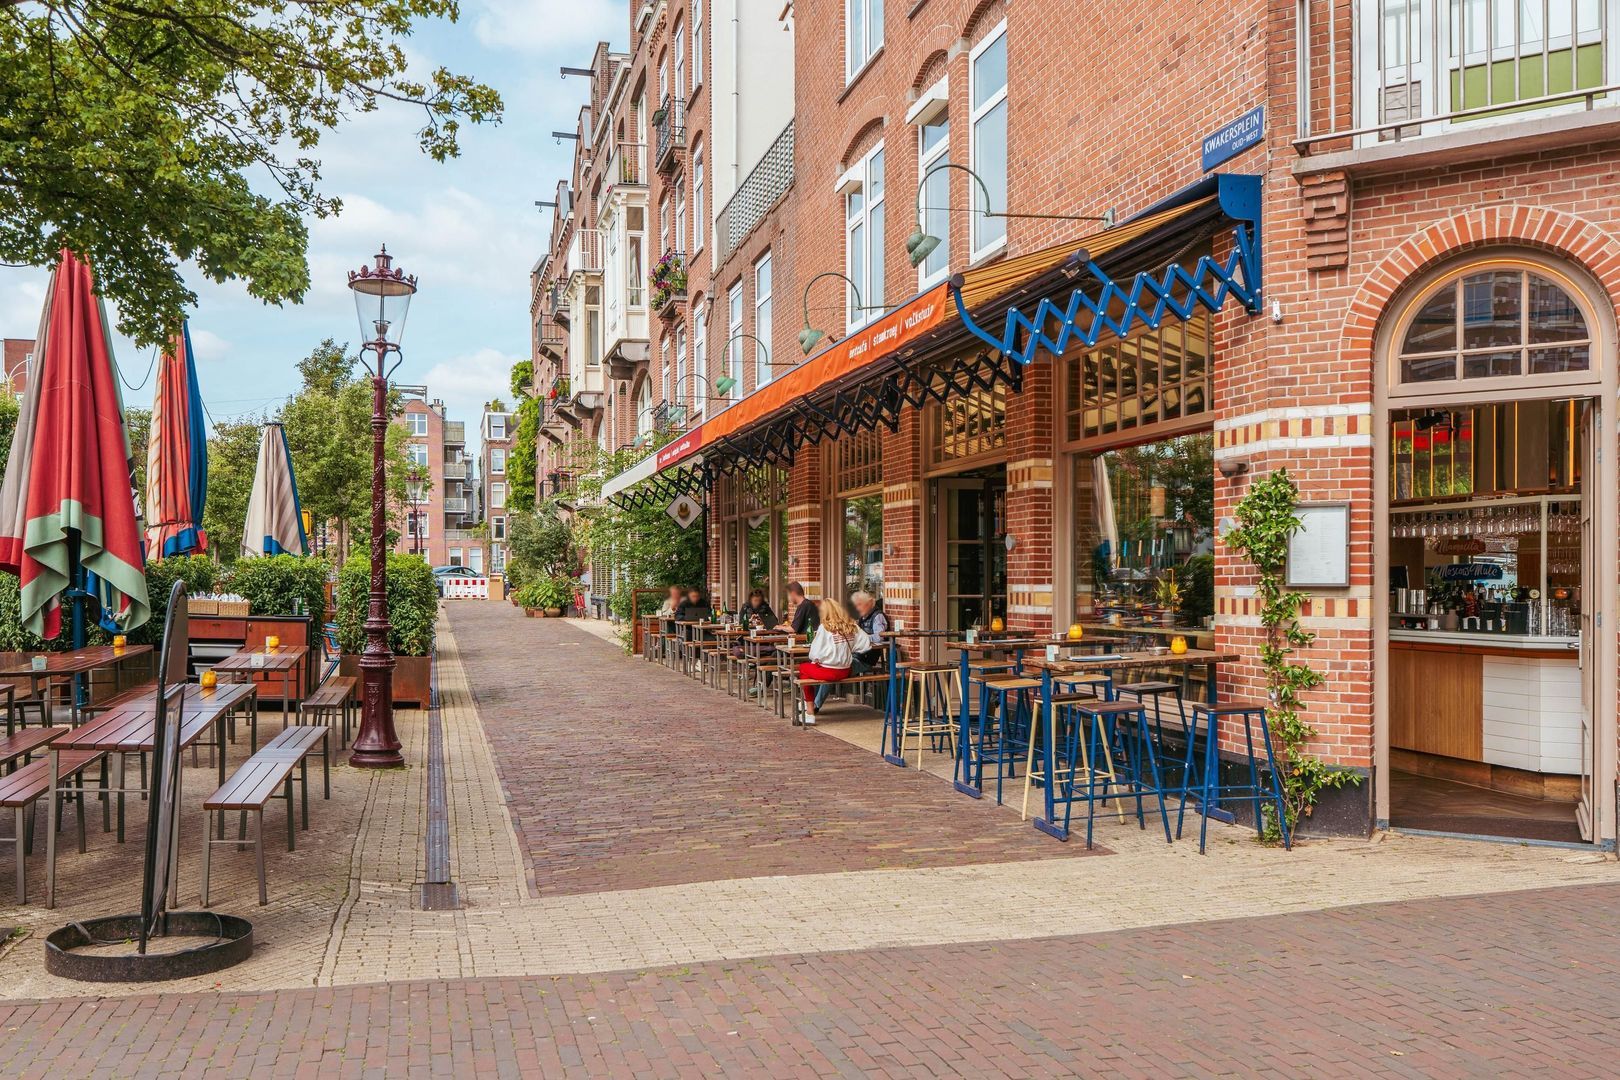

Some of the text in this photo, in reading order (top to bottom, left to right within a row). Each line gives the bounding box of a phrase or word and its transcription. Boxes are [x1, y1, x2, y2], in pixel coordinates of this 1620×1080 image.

[1204, 112, 1260, 154] KWAKERSPLEIN
[1232, 130, 1259, 151] OUD-WEST
[1431, 564, 1497, 577] Moscow Mule
